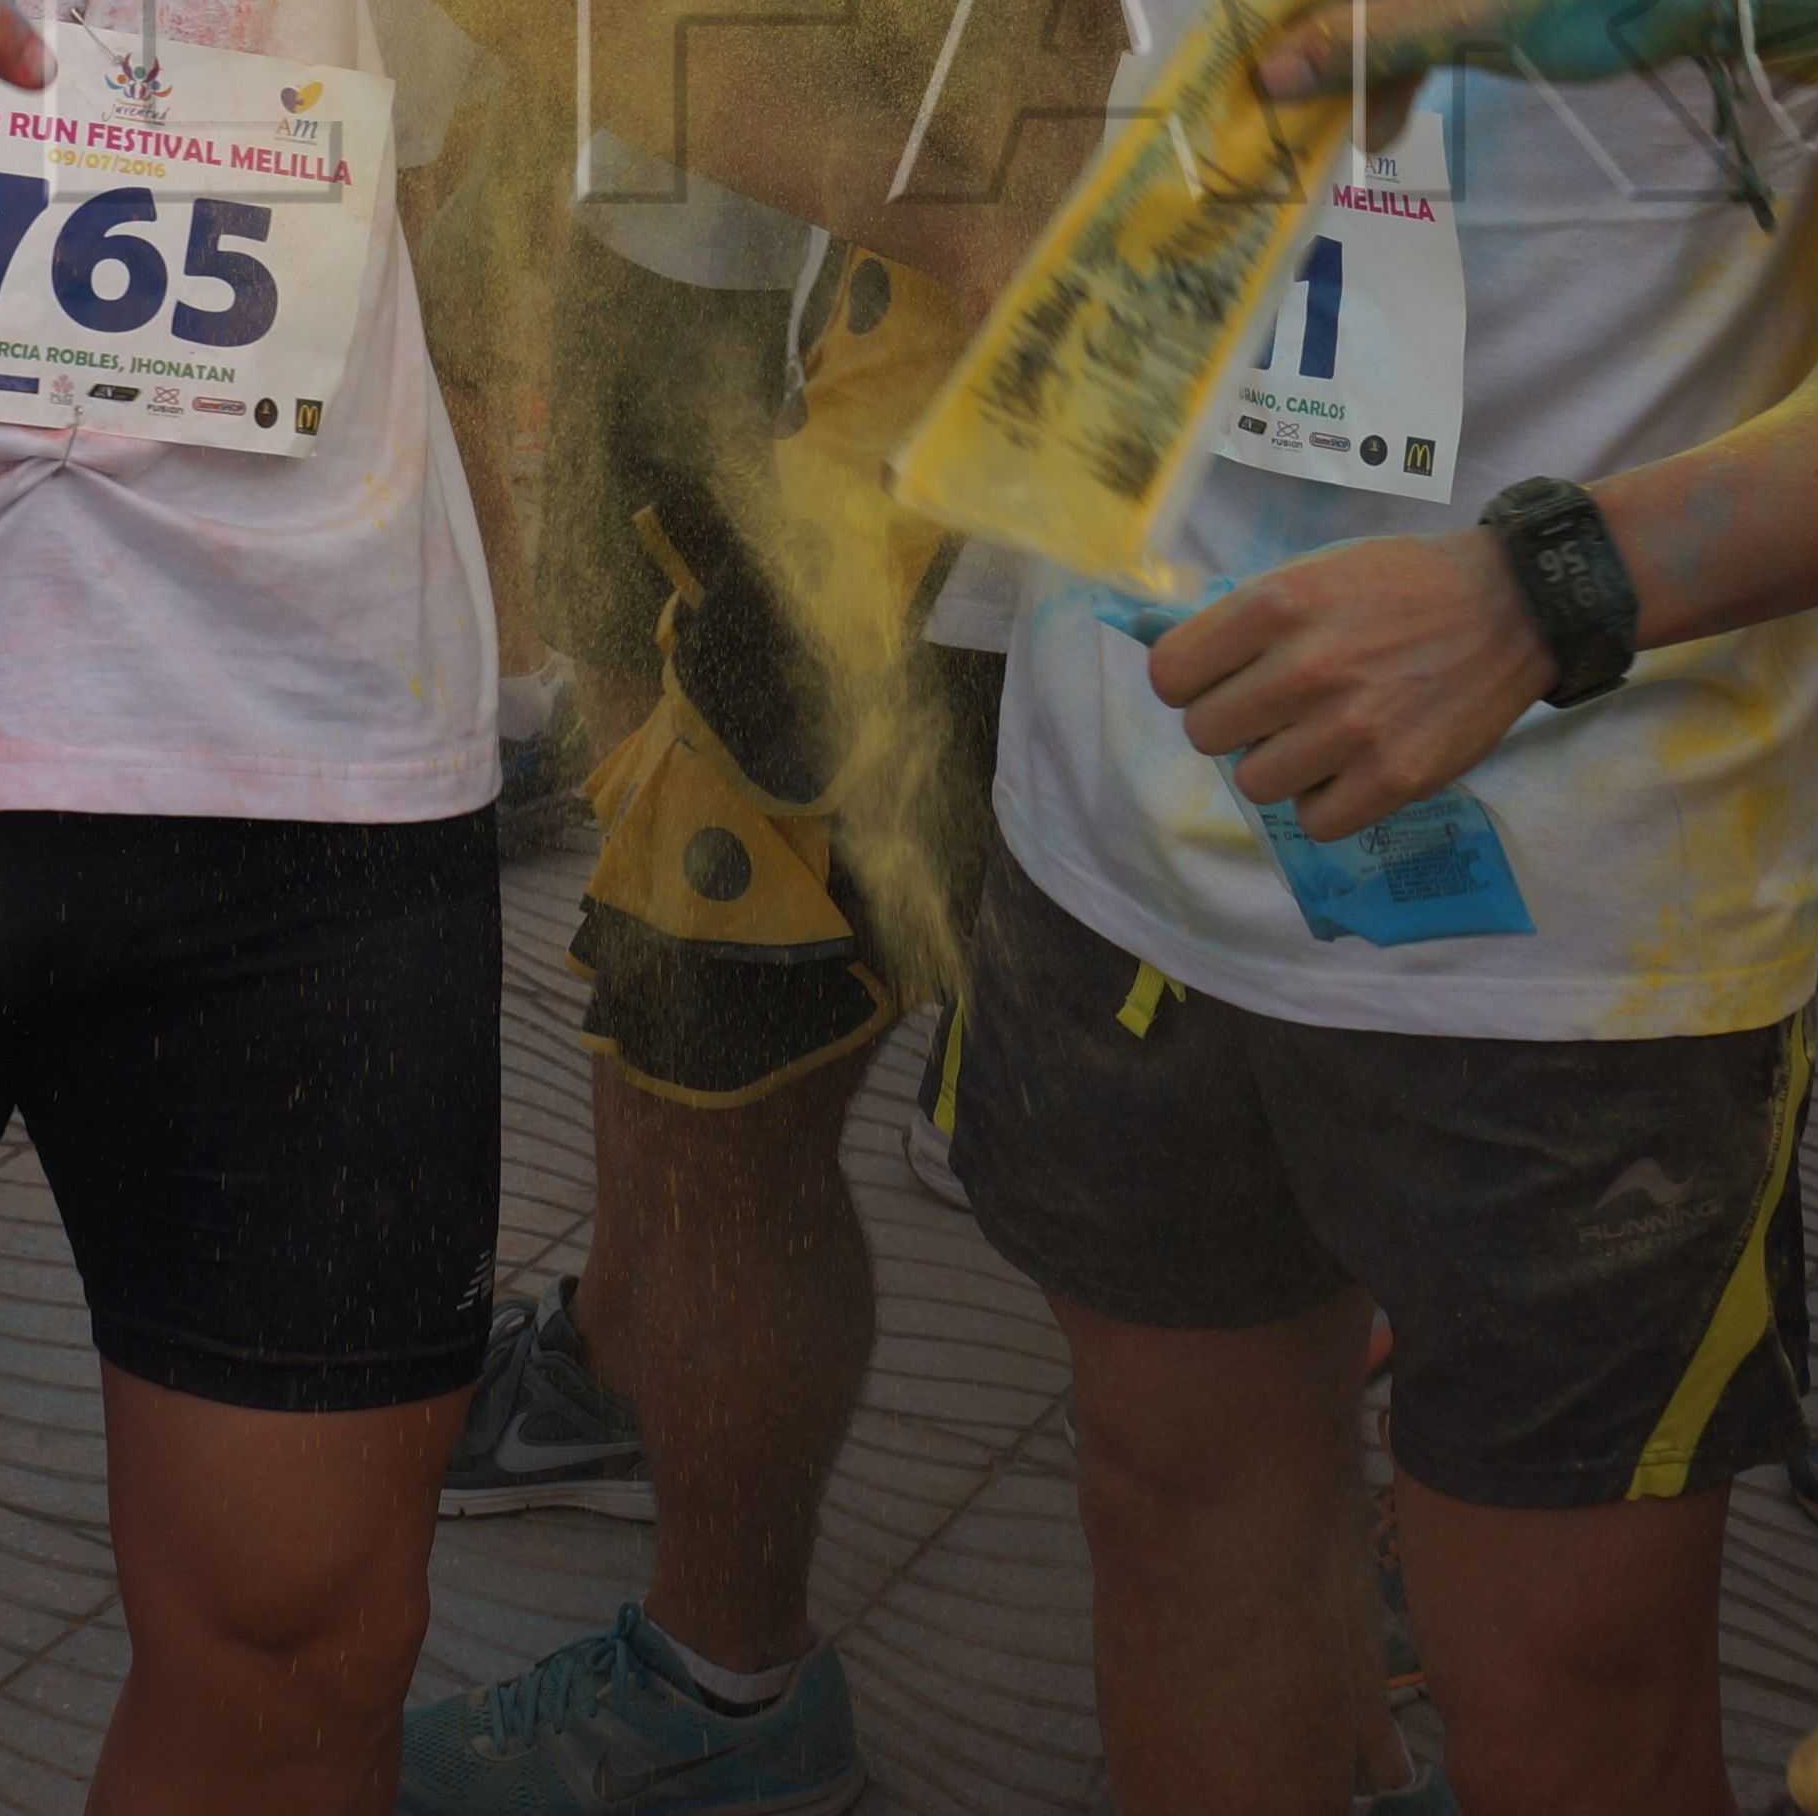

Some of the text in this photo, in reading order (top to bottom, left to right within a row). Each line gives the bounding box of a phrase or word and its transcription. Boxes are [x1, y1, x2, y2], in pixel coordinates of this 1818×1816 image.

[10, 112, 78, 144] RUN
[86, 122, 222, 166] FESTIVAL
[231, 144, 353, 186] MELILLA
[1332, 184, 1436, 222] MELILLA
[46, 347, 124, 373] ROBLES,
[130, 356, 236, 384] JHONATAN
[1286, 397, 1346, 420] CARLOS
